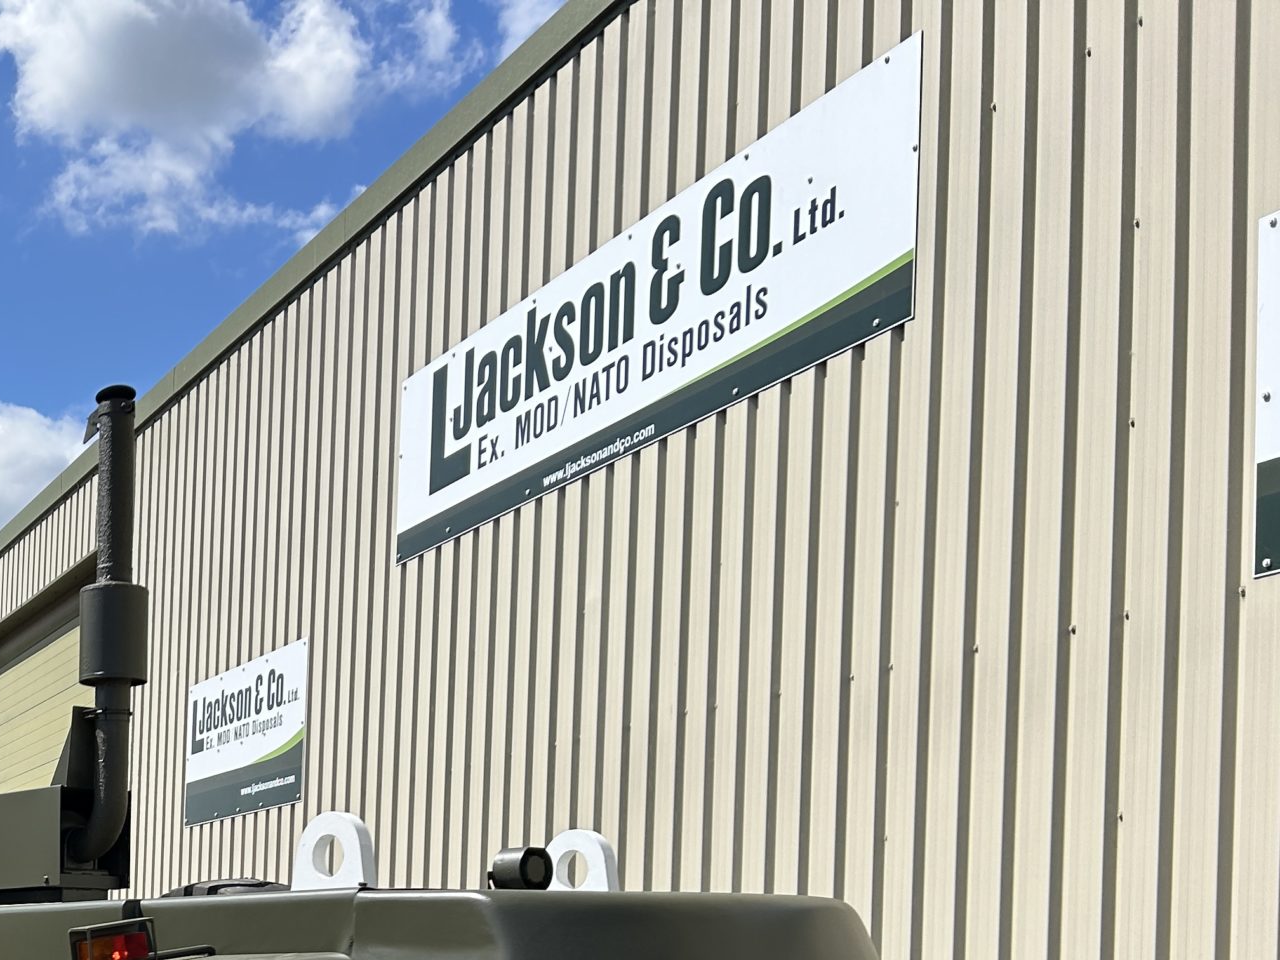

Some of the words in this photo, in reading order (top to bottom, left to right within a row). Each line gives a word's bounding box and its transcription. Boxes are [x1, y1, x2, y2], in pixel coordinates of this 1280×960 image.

[649, 215, 685, 325] &
[699, 174, 782, 296] Co.
[793, 185, 845, 245] Ltd.
[476, 434, 505, 470] Ex.
[641, 283, 768, 382] Disposals
[542, 424, 655, 487] www.ljacksonandco.com
[254, 674, 264, 715] &
[267, 668, 286, 710] Co.
[252, 711, 282, 736] Disposals
